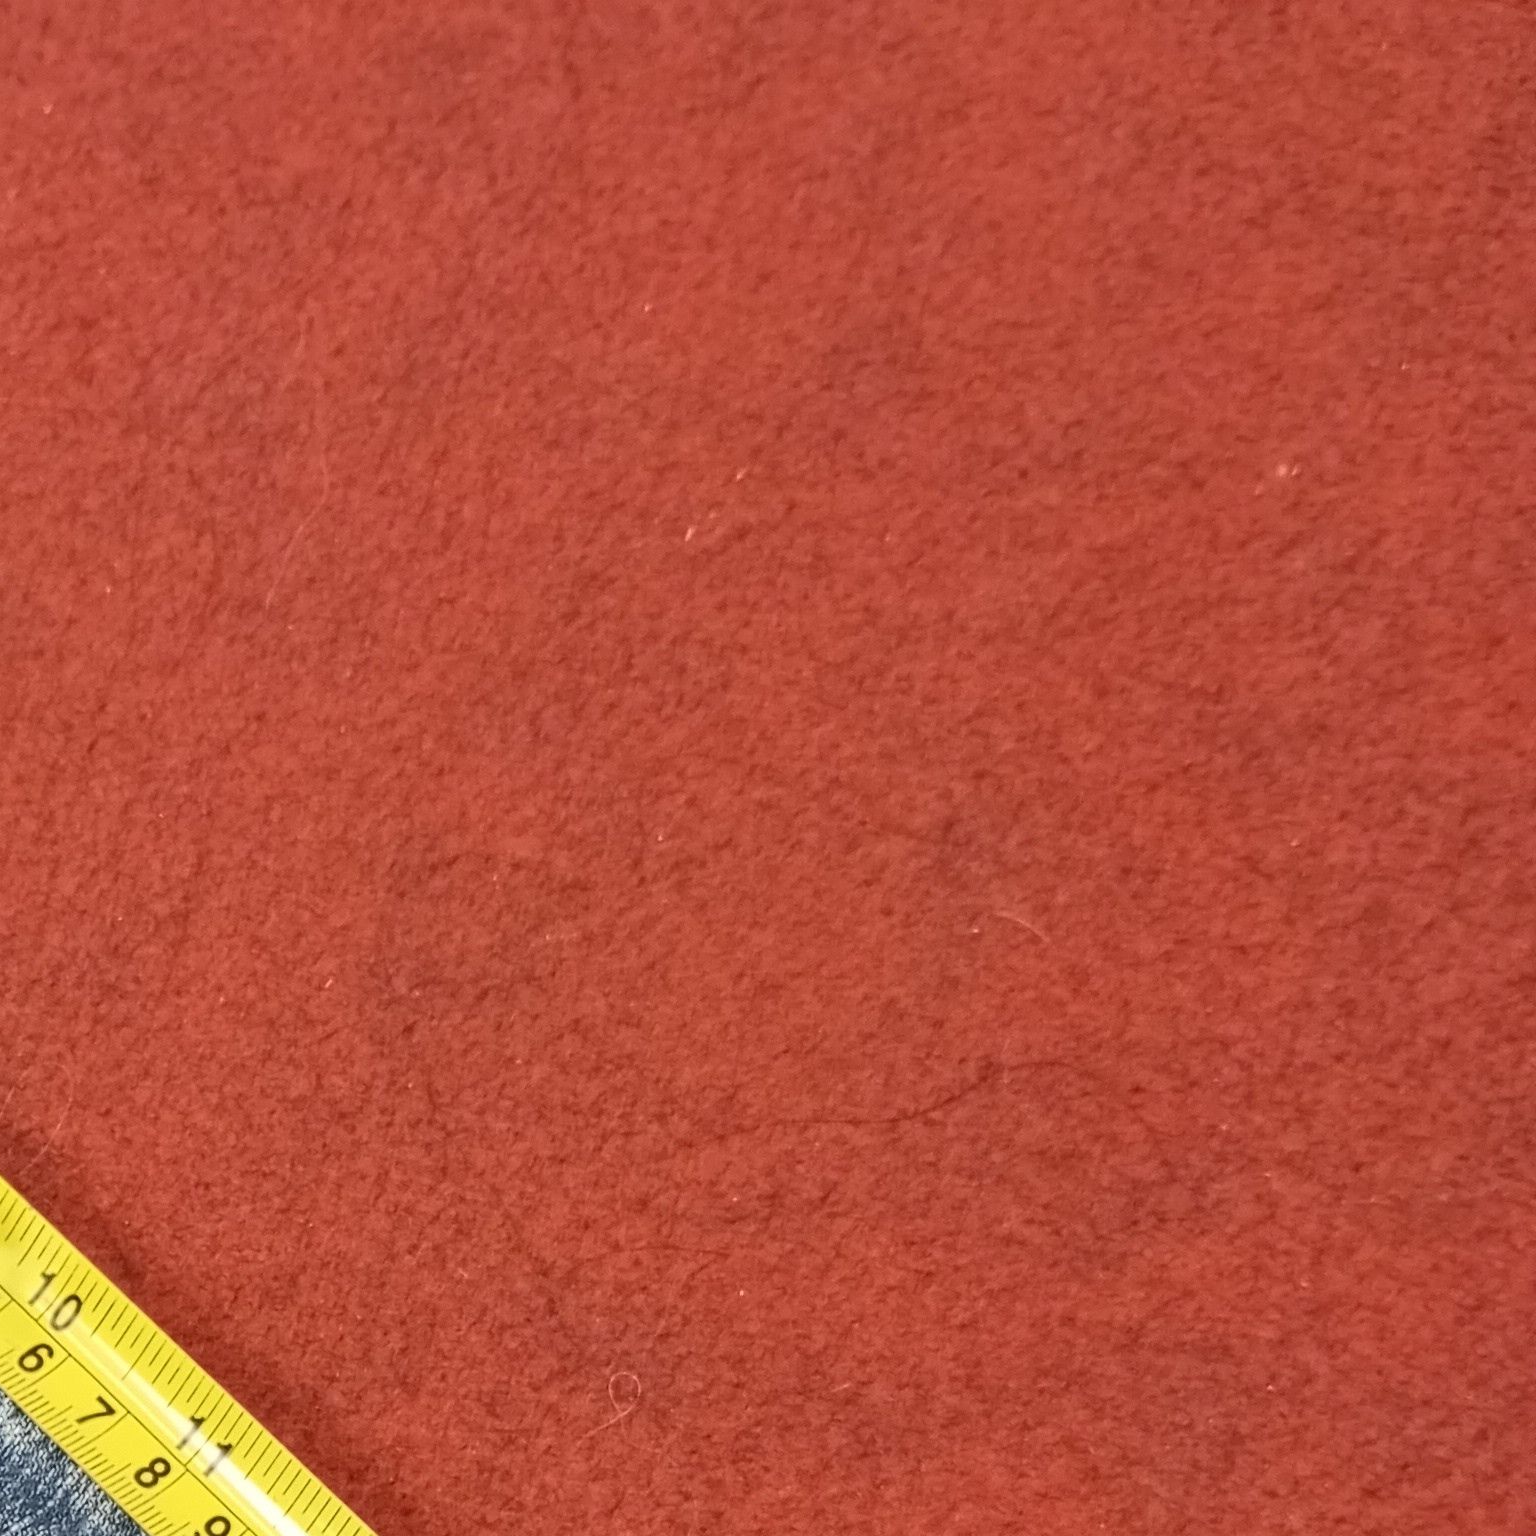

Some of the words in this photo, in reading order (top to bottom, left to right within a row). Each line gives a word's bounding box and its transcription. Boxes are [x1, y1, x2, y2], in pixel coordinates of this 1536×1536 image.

[28, 1271, 84, 1332] 10
[18, 1342, 54, 1373] 6
[77, 1395, 116, 1425] 7
[134, 1457, 172, 1489] 8
